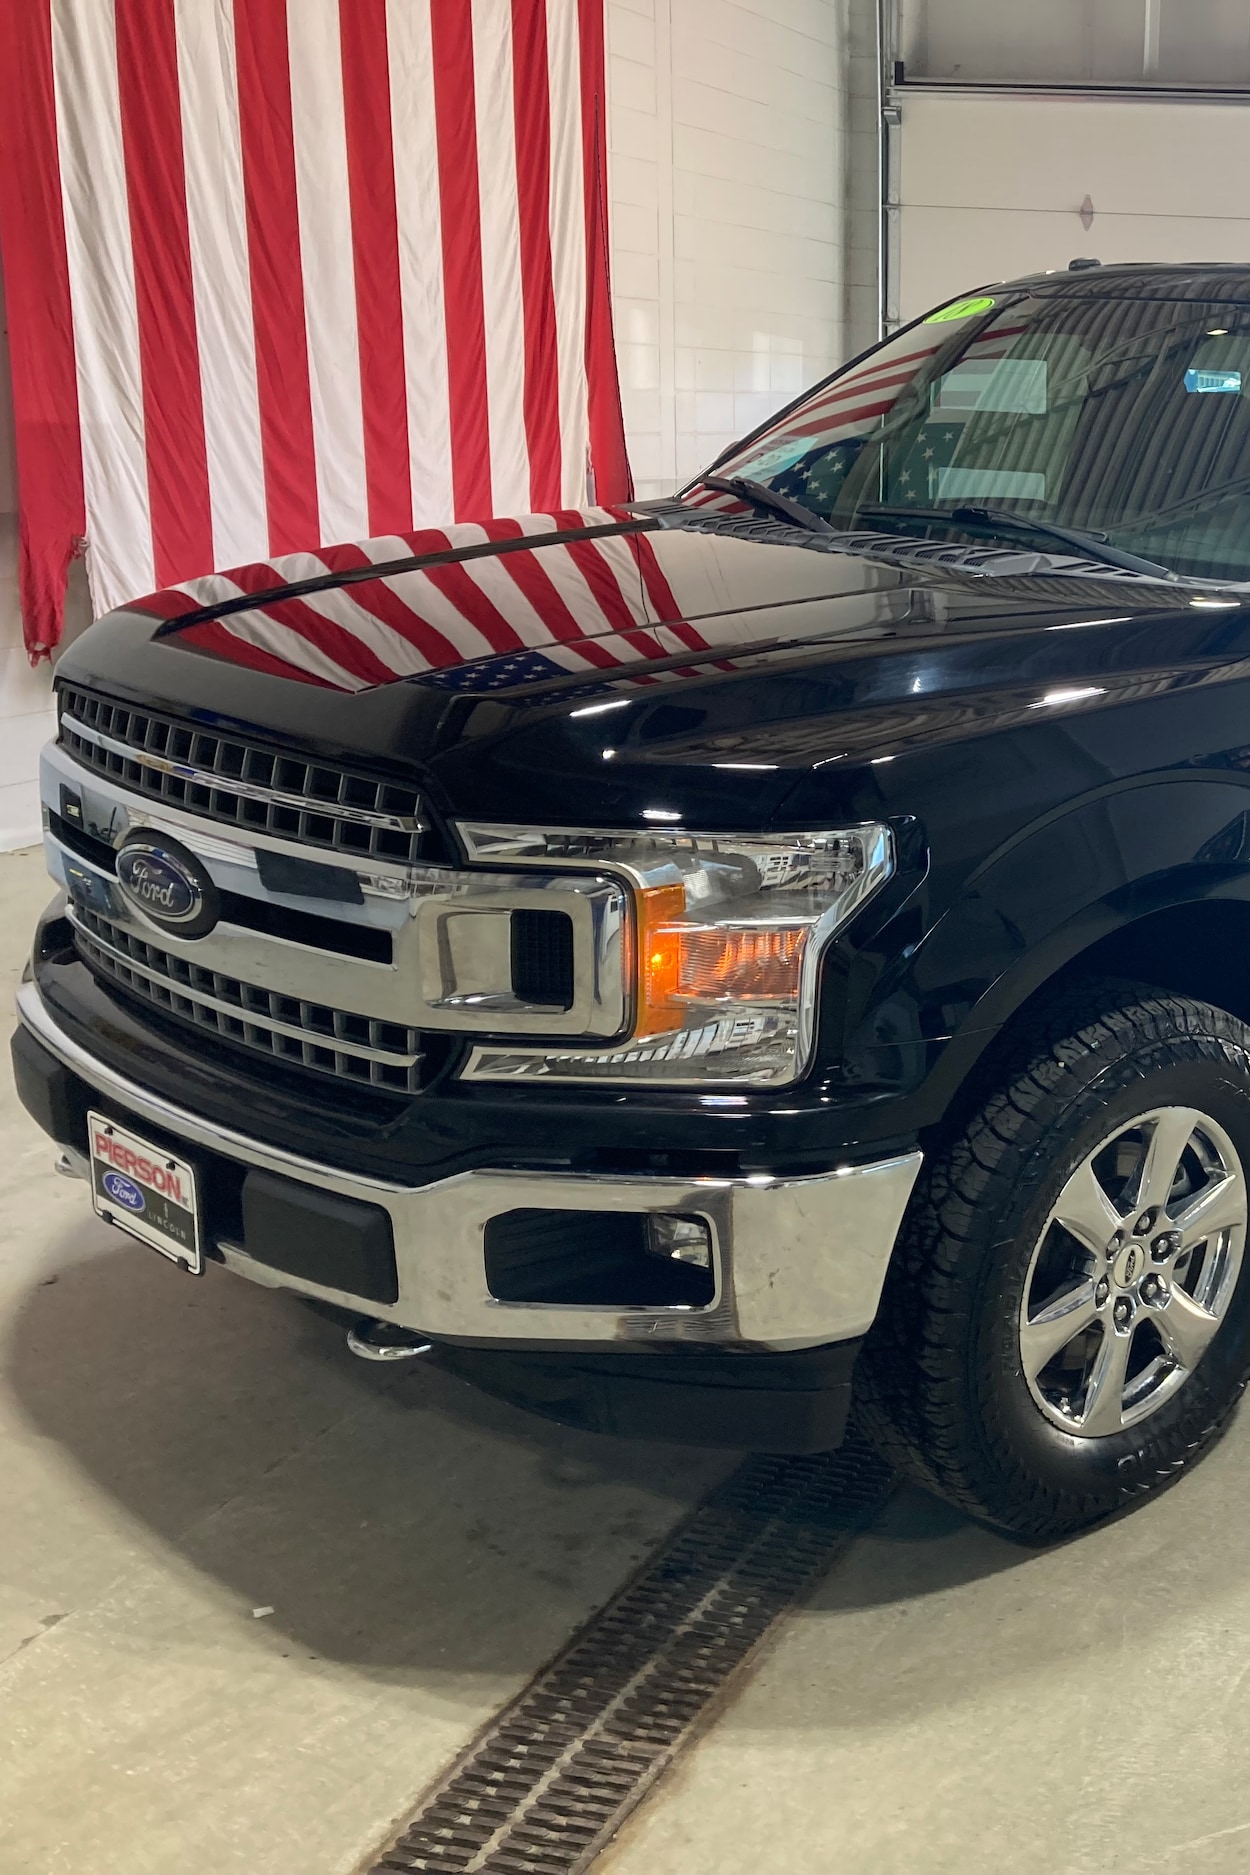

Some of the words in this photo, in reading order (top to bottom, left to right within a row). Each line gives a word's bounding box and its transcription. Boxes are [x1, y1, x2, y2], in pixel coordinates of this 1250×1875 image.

[130, 859, 175, 907] Ford
[95, 1134, 182, 1200] PIERSON
[112, 1177, 137, 1205] Ford
[149, 1212, 187, 1240] LINCOLN
